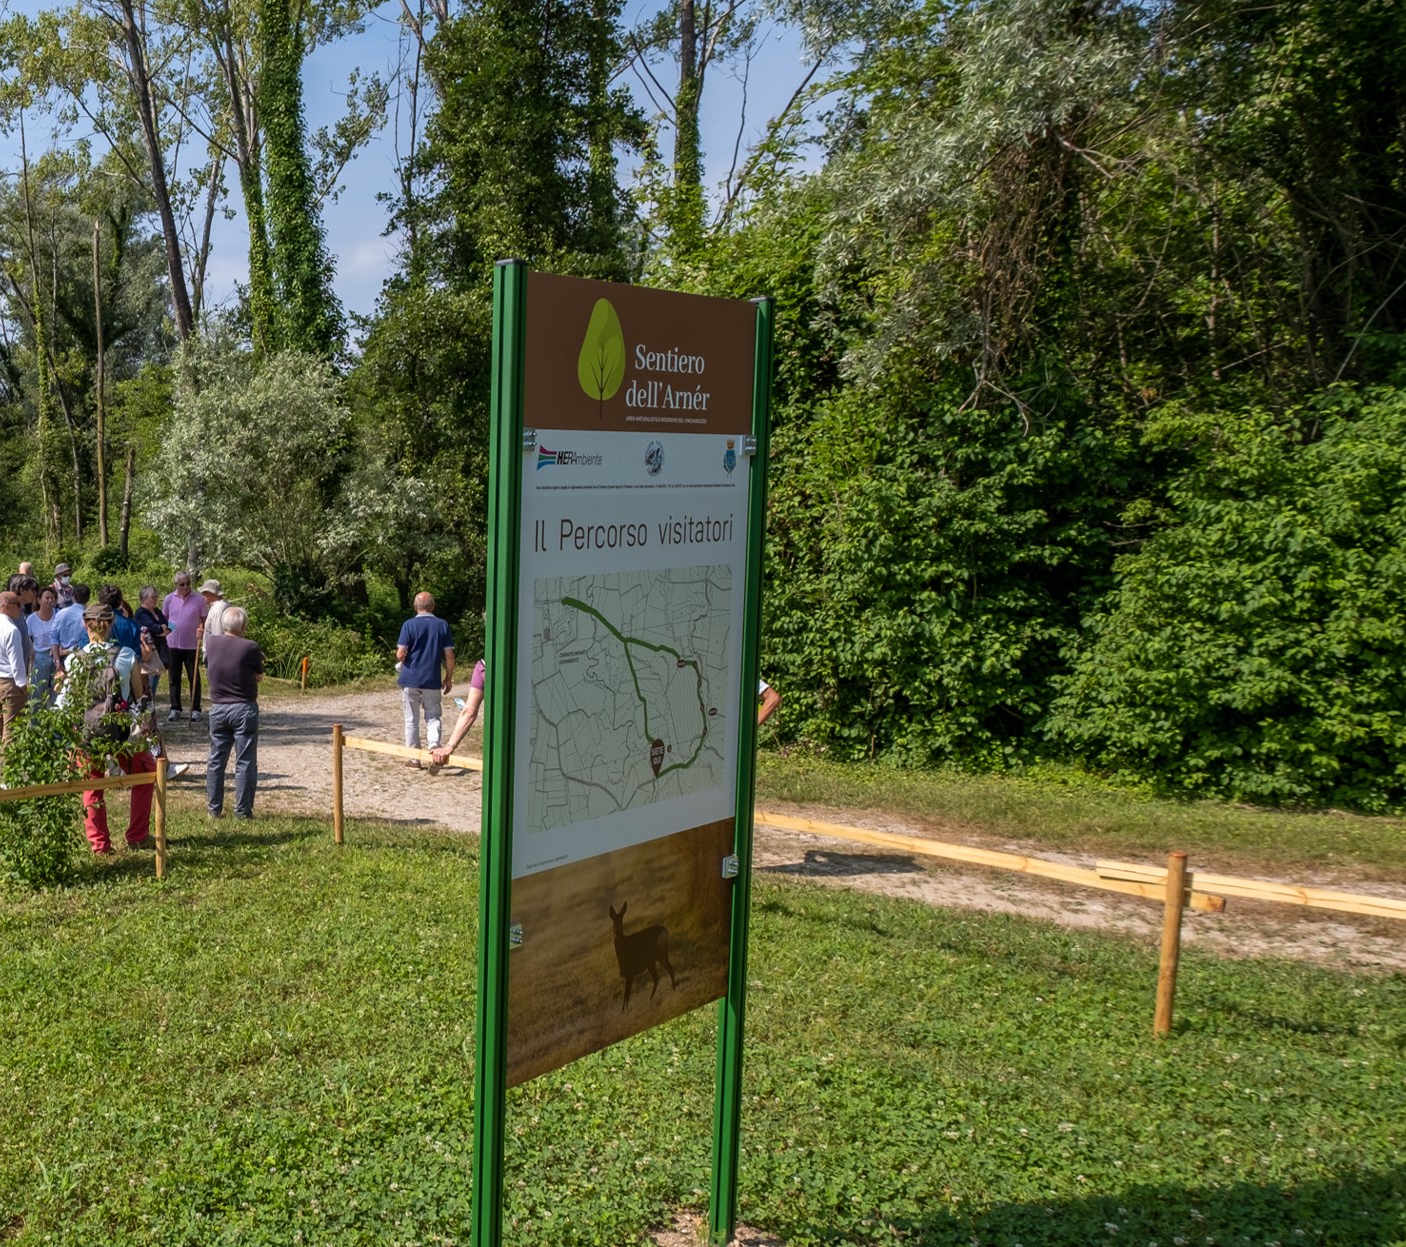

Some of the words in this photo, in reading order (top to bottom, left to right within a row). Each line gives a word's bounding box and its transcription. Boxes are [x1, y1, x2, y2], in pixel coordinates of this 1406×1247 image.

[635, 344, 705, 375] Sentiero
[625, 379, 710, 411] dell'Arnér
[535, 519, 547, 552] Il
[559, 518, 648, 551] Percorso
[658, 513, 733, 545] visitatori
